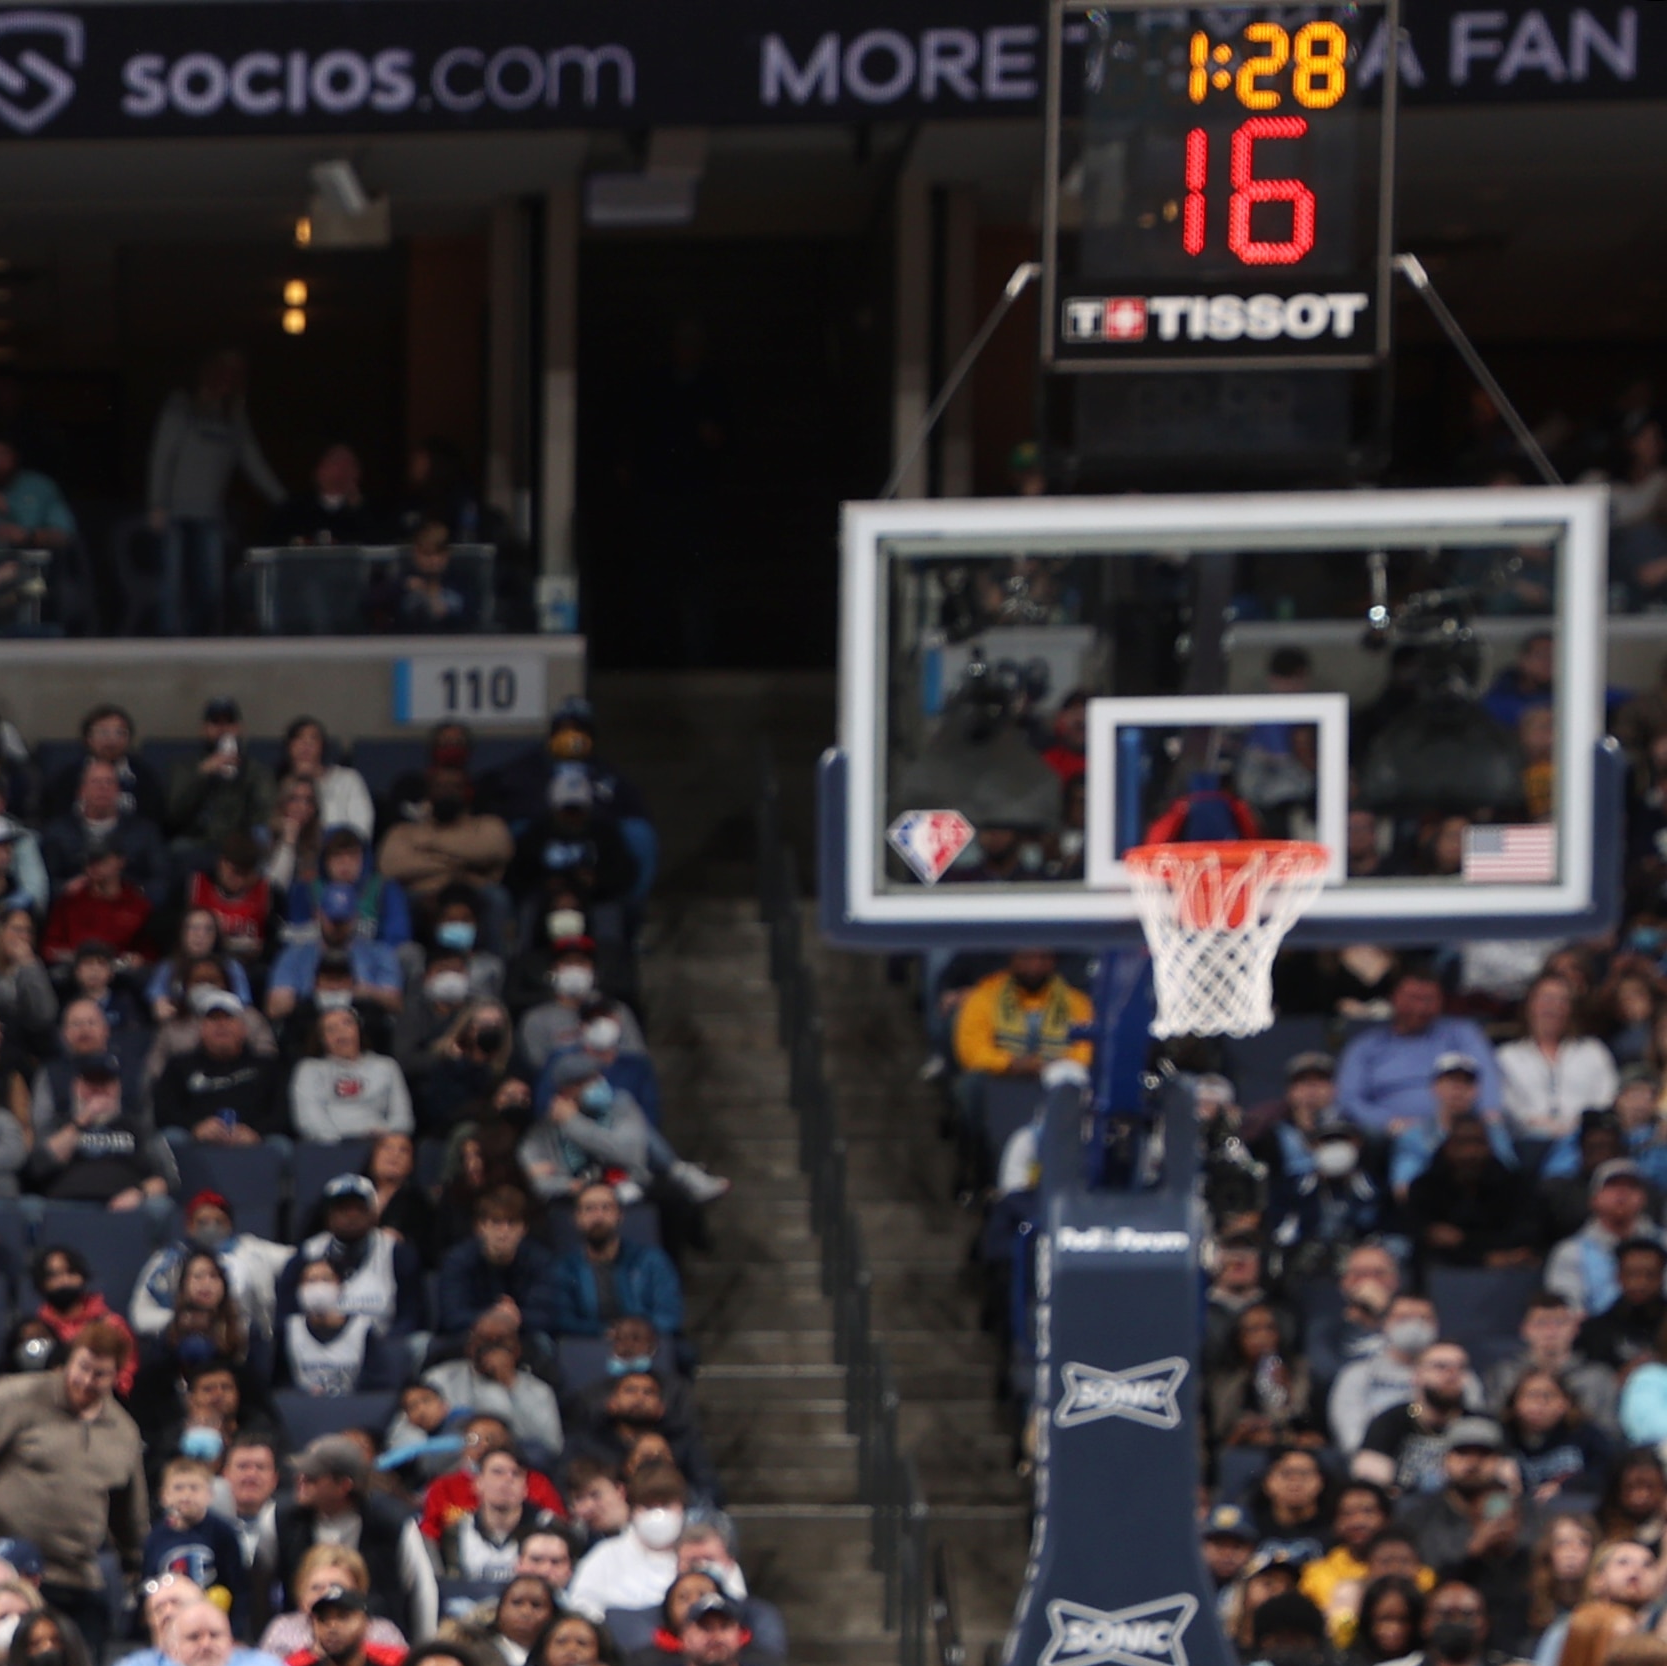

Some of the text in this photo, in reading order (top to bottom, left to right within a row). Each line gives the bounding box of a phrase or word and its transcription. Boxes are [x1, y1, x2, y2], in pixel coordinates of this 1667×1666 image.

[760, 26, 1037, 104] MORE
[1449, 11, 1638, 84] FAN
[1188, 20, 1347, 110] 1:28
[1182, 115, 1317, 266] 16
[1150, 293, 1368, 341] TISSOT
[439, 667, 518, 712] 110
[1073, 1379, 1169, 1410] SONIC
[1060, 1619, 1173, 1656] SONIC
